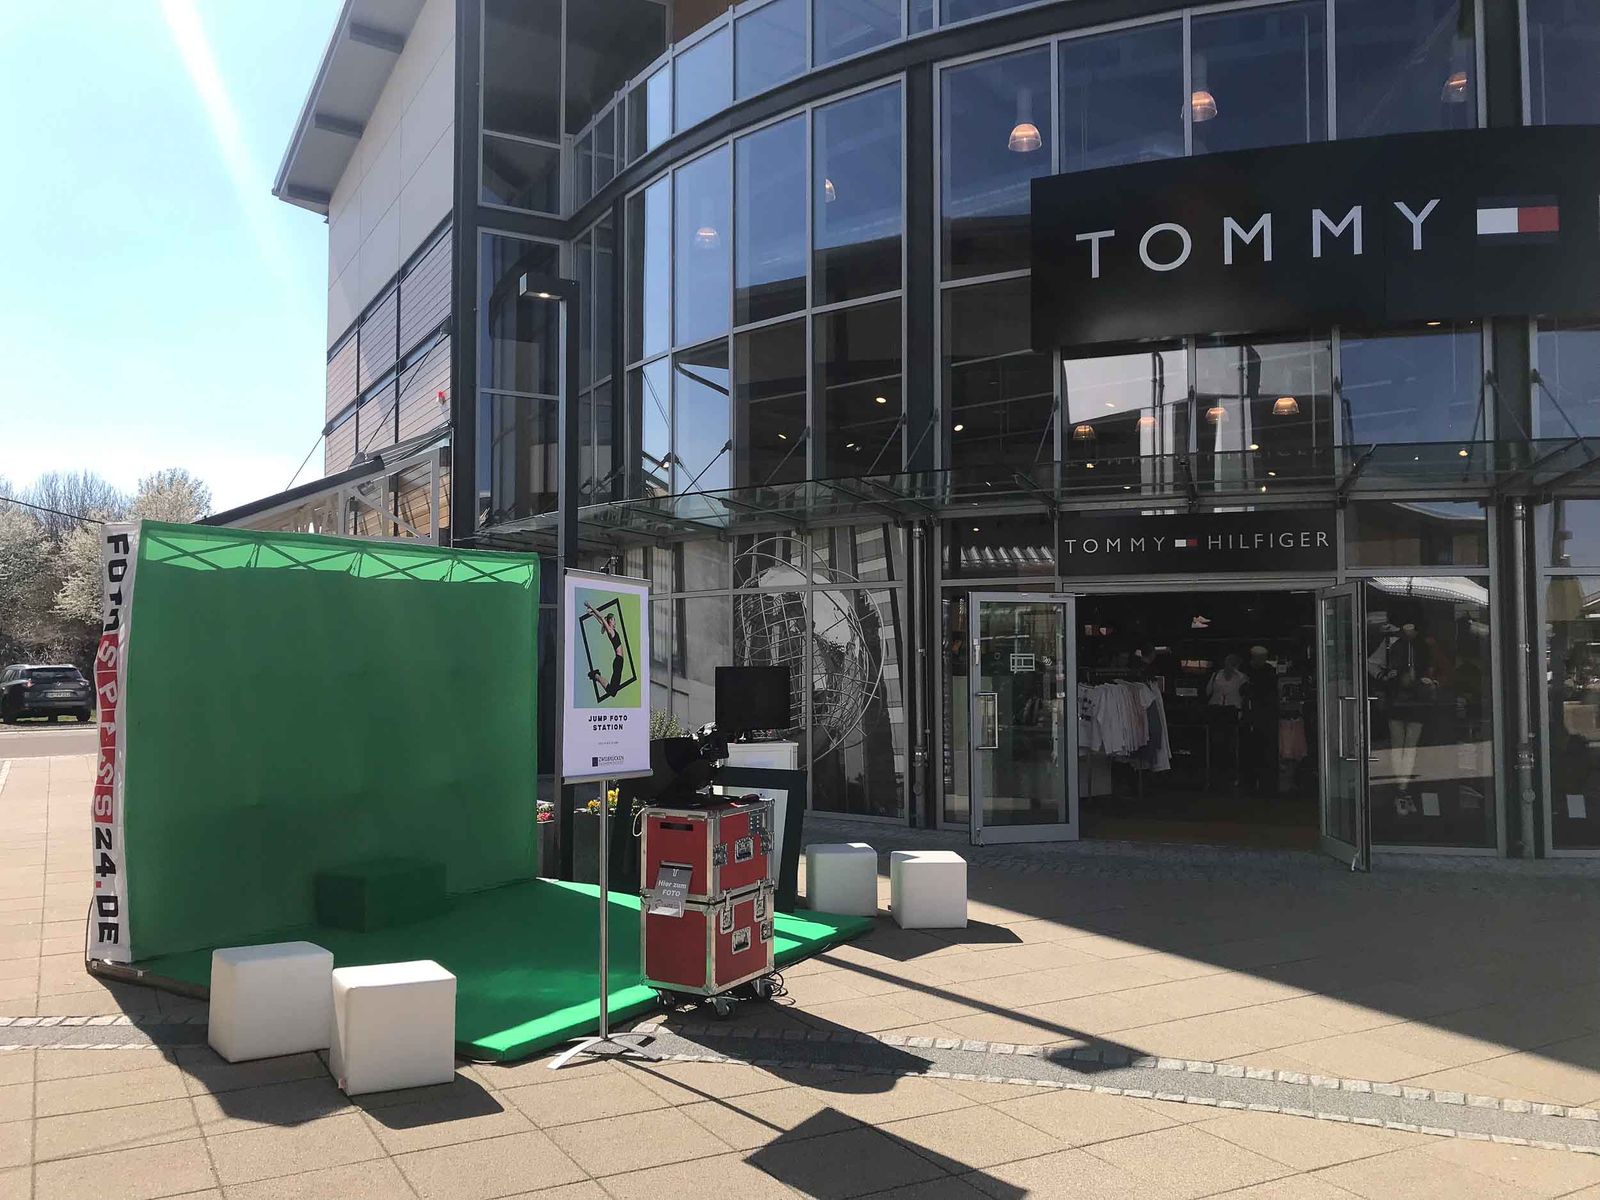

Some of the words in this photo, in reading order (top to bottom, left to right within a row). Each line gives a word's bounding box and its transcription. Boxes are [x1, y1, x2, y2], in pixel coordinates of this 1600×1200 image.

[1075, 198, 1441, 279] TOMMY
[1064, 535, 1166, 554] TOMMY
[1207, 530, 1330, 550] HILFIGER
[610, 714, 628, 722] FOTO
[592, 723, 624, 731] STATION
[658, 880, 673, 888] Hier
[662, 889, 681, 897] FOTO
